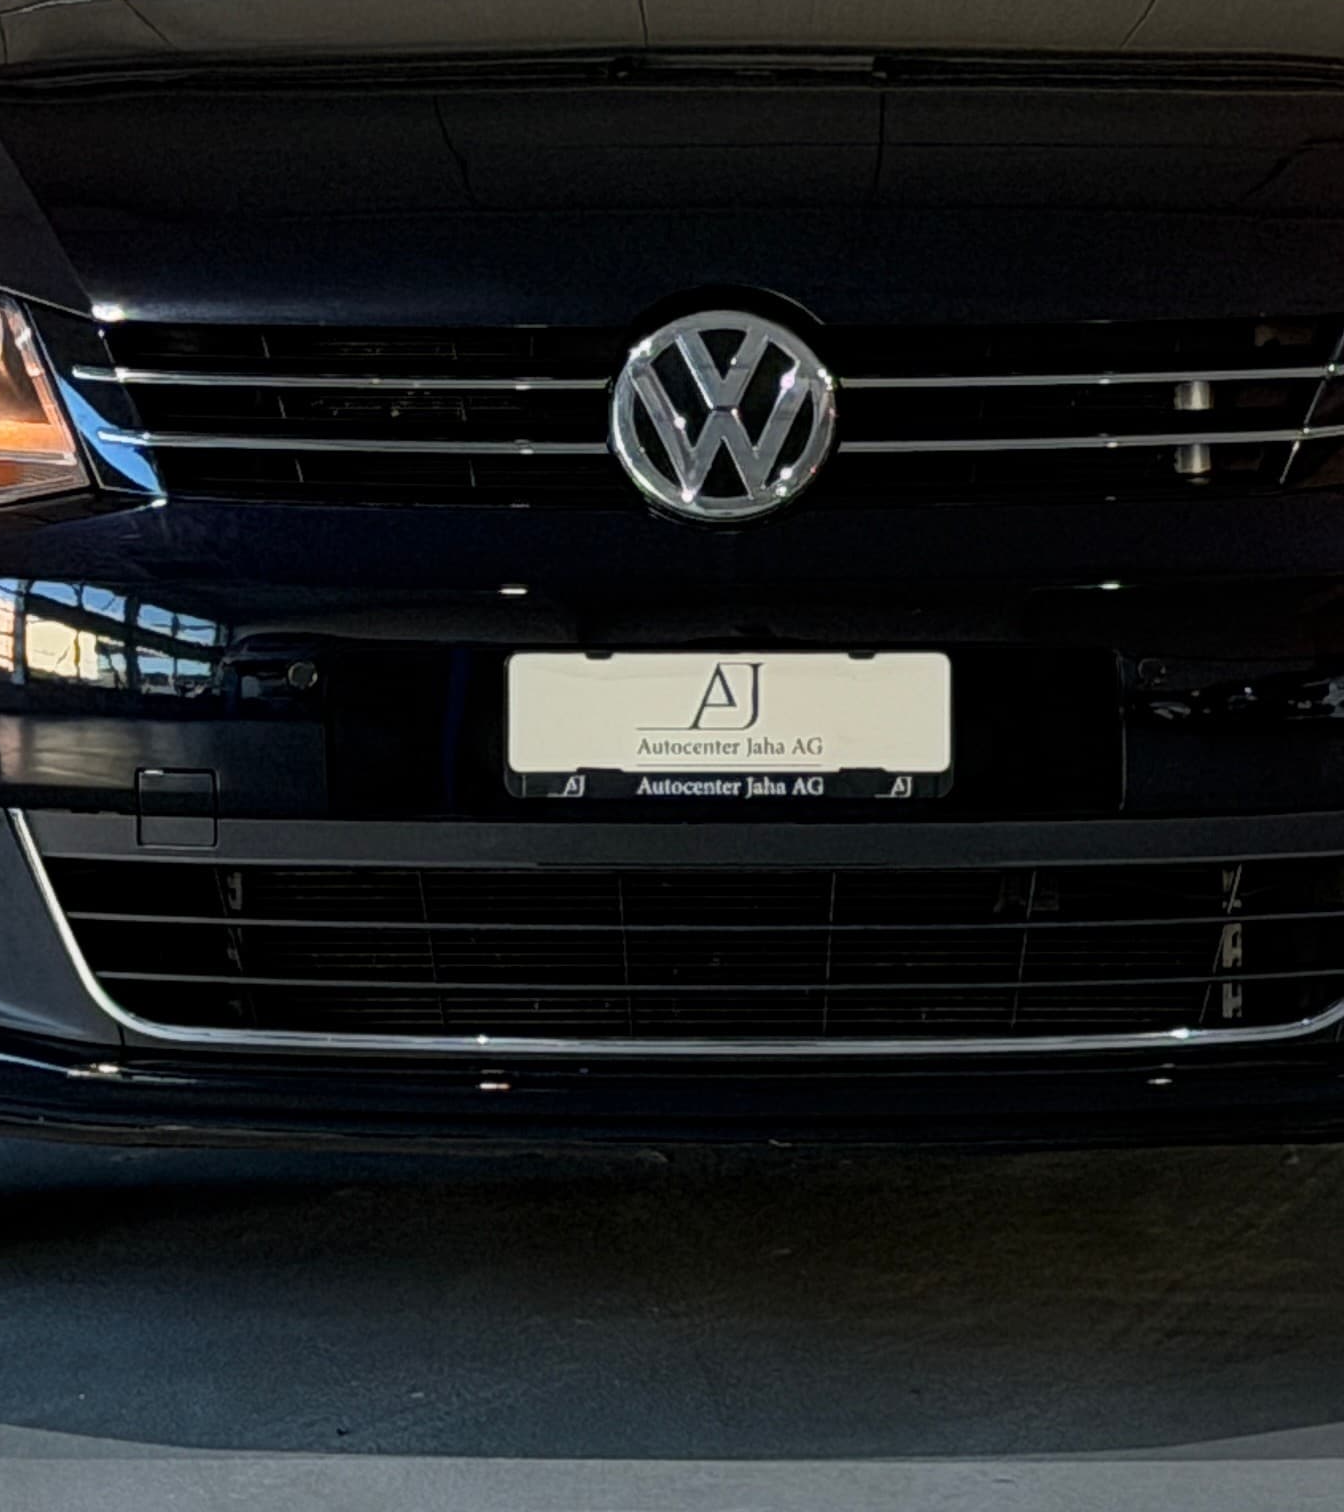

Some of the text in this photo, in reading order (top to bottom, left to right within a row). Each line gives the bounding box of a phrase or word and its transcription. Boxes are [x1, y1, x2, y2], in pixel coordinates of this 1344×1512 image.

[688, 662, 765, 731] AJ
[637, 736, 824, 758] Autocenter Jaha AG
[563, 774, 586, 798] AJ
[635, 775, 825, 799] Autocenter Jaha AG
[890, 776, 913, 798] AJ
